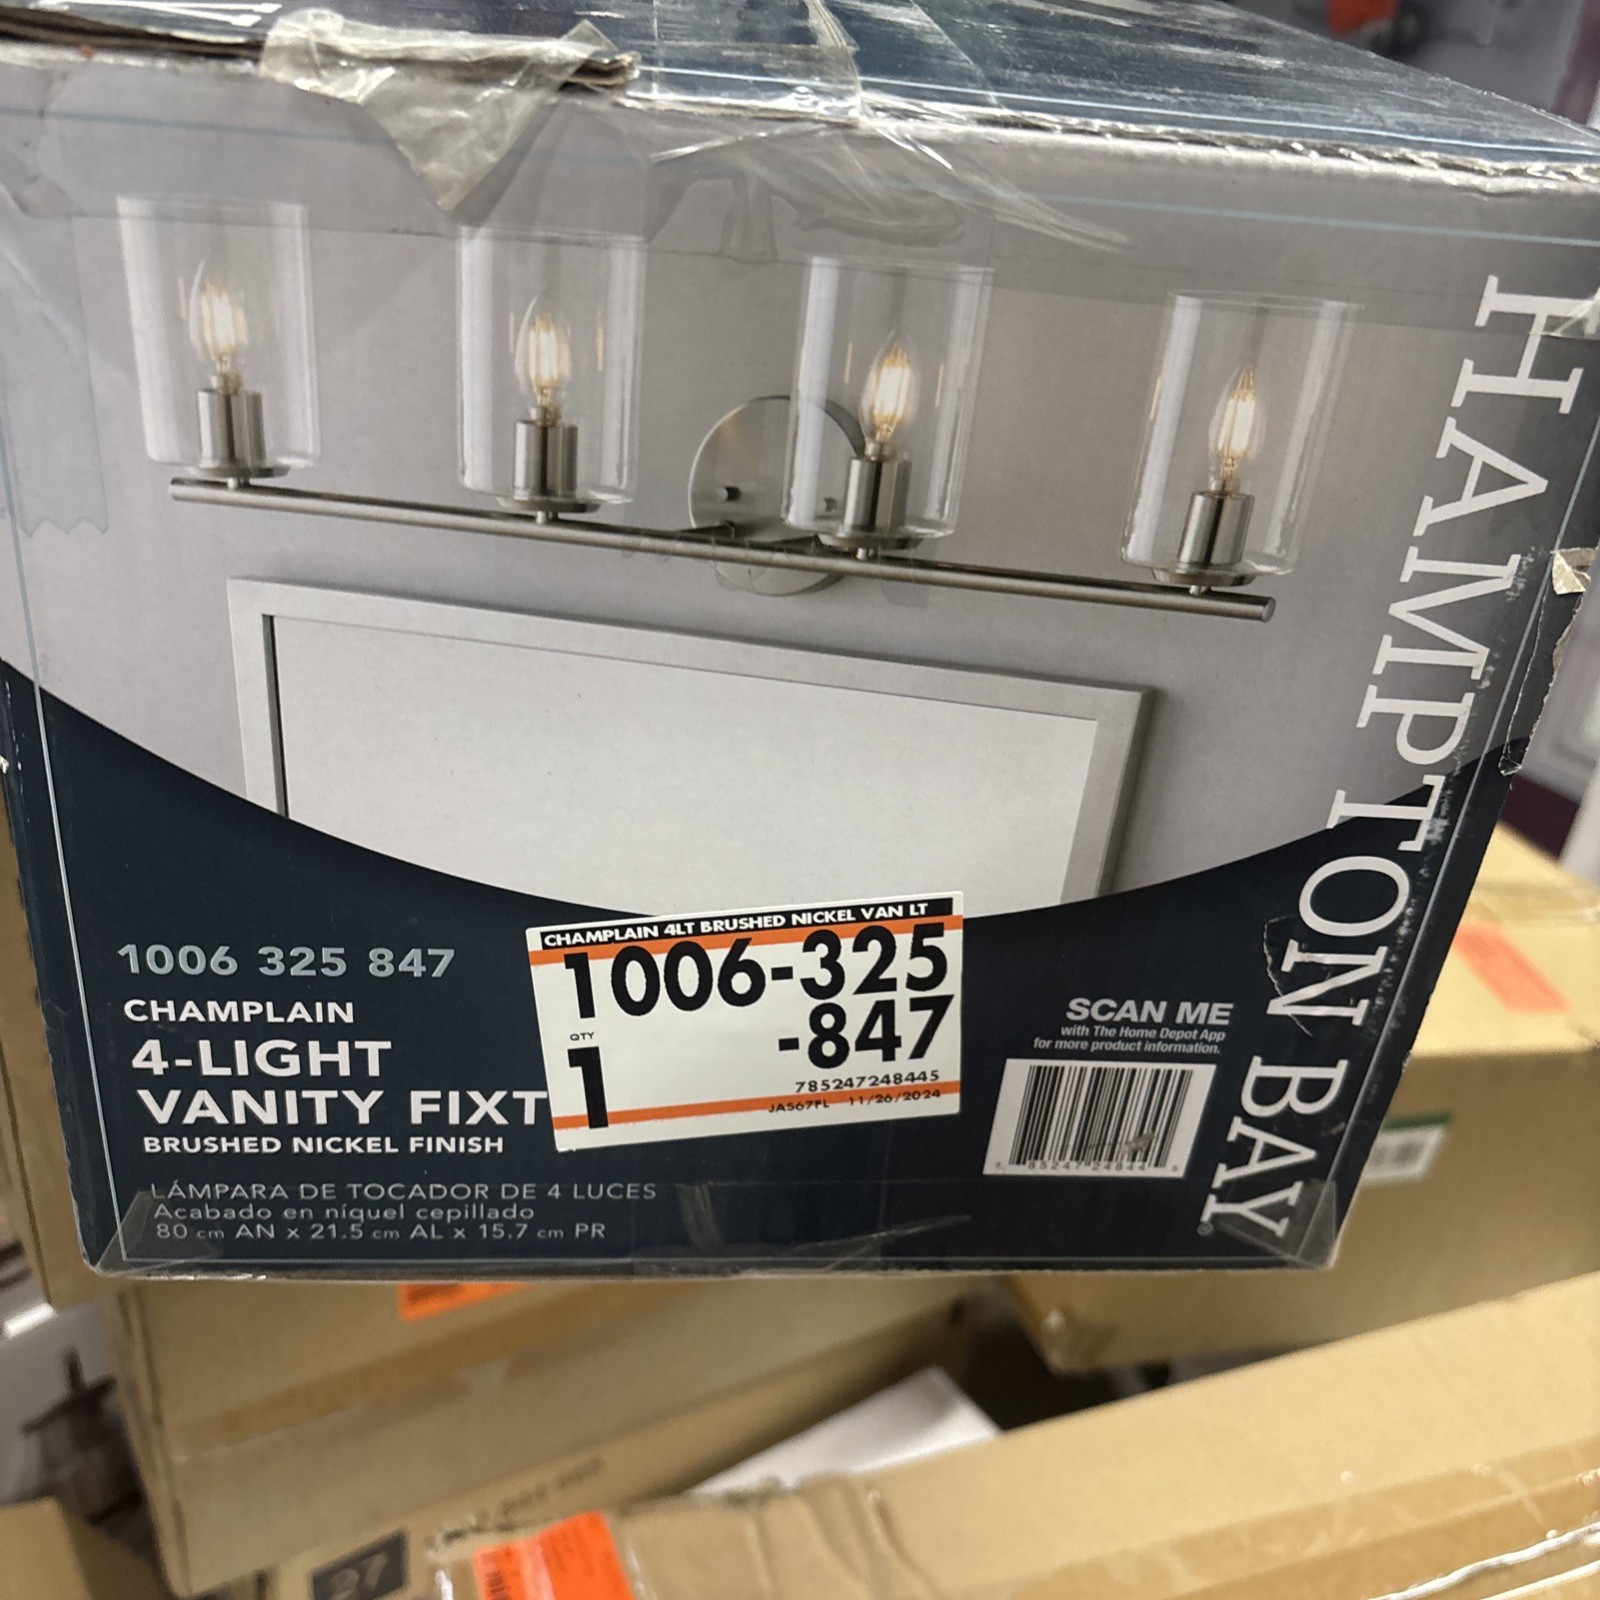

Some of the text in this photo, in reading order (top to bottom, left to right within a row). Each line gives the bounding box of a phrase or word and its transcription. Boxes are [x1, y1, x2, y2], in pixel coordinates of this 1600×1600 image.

[1200, 274, 1600, 1238] HAMPTON BAY
[544, 901, 929, 948] CHAMPLAIN 4LT BRUSHED NICKEL VAN LT
[118, 943, 455, 978] 1006 325 847
[564, 921, 949, 1020] 1006-325
[123, 999, 354, 1024] CHAMPLAIN
[1065, 997, 1235, 1027] SCAN ME
[570, 1031, 595, 1042] QTY
[778, 994, 955, 1070] -847
[1060, 1024, 1227, 1042] with The Home Depot App
[131, 1040, 392, 1077] 4-LIGHT
[1033, 1037, 1221, 1055] for more product information.
[567, 1046, 609, 1130] 1
[796, 1070, 940, 1094] 785247248445
[136, 1089, 384, 1125] VANITY
[848, 1088, 941, 1107] 11/26/2024
[144, 1136, 504, 1153] BRUSHED NICKEL FINISH
[151, 1180, 657, 1201] LÁMPARA DE TOCADOR DE 4 LUCES
[153, 1203, 272, 1220] Acabado
[283, 1208, 314, 1220] en
[416, 1203, 535, 1224] cepillado
[156, 1222, 606, 1240] 80 cm AN x 21.5 cm AL x 15.7 cm PR
